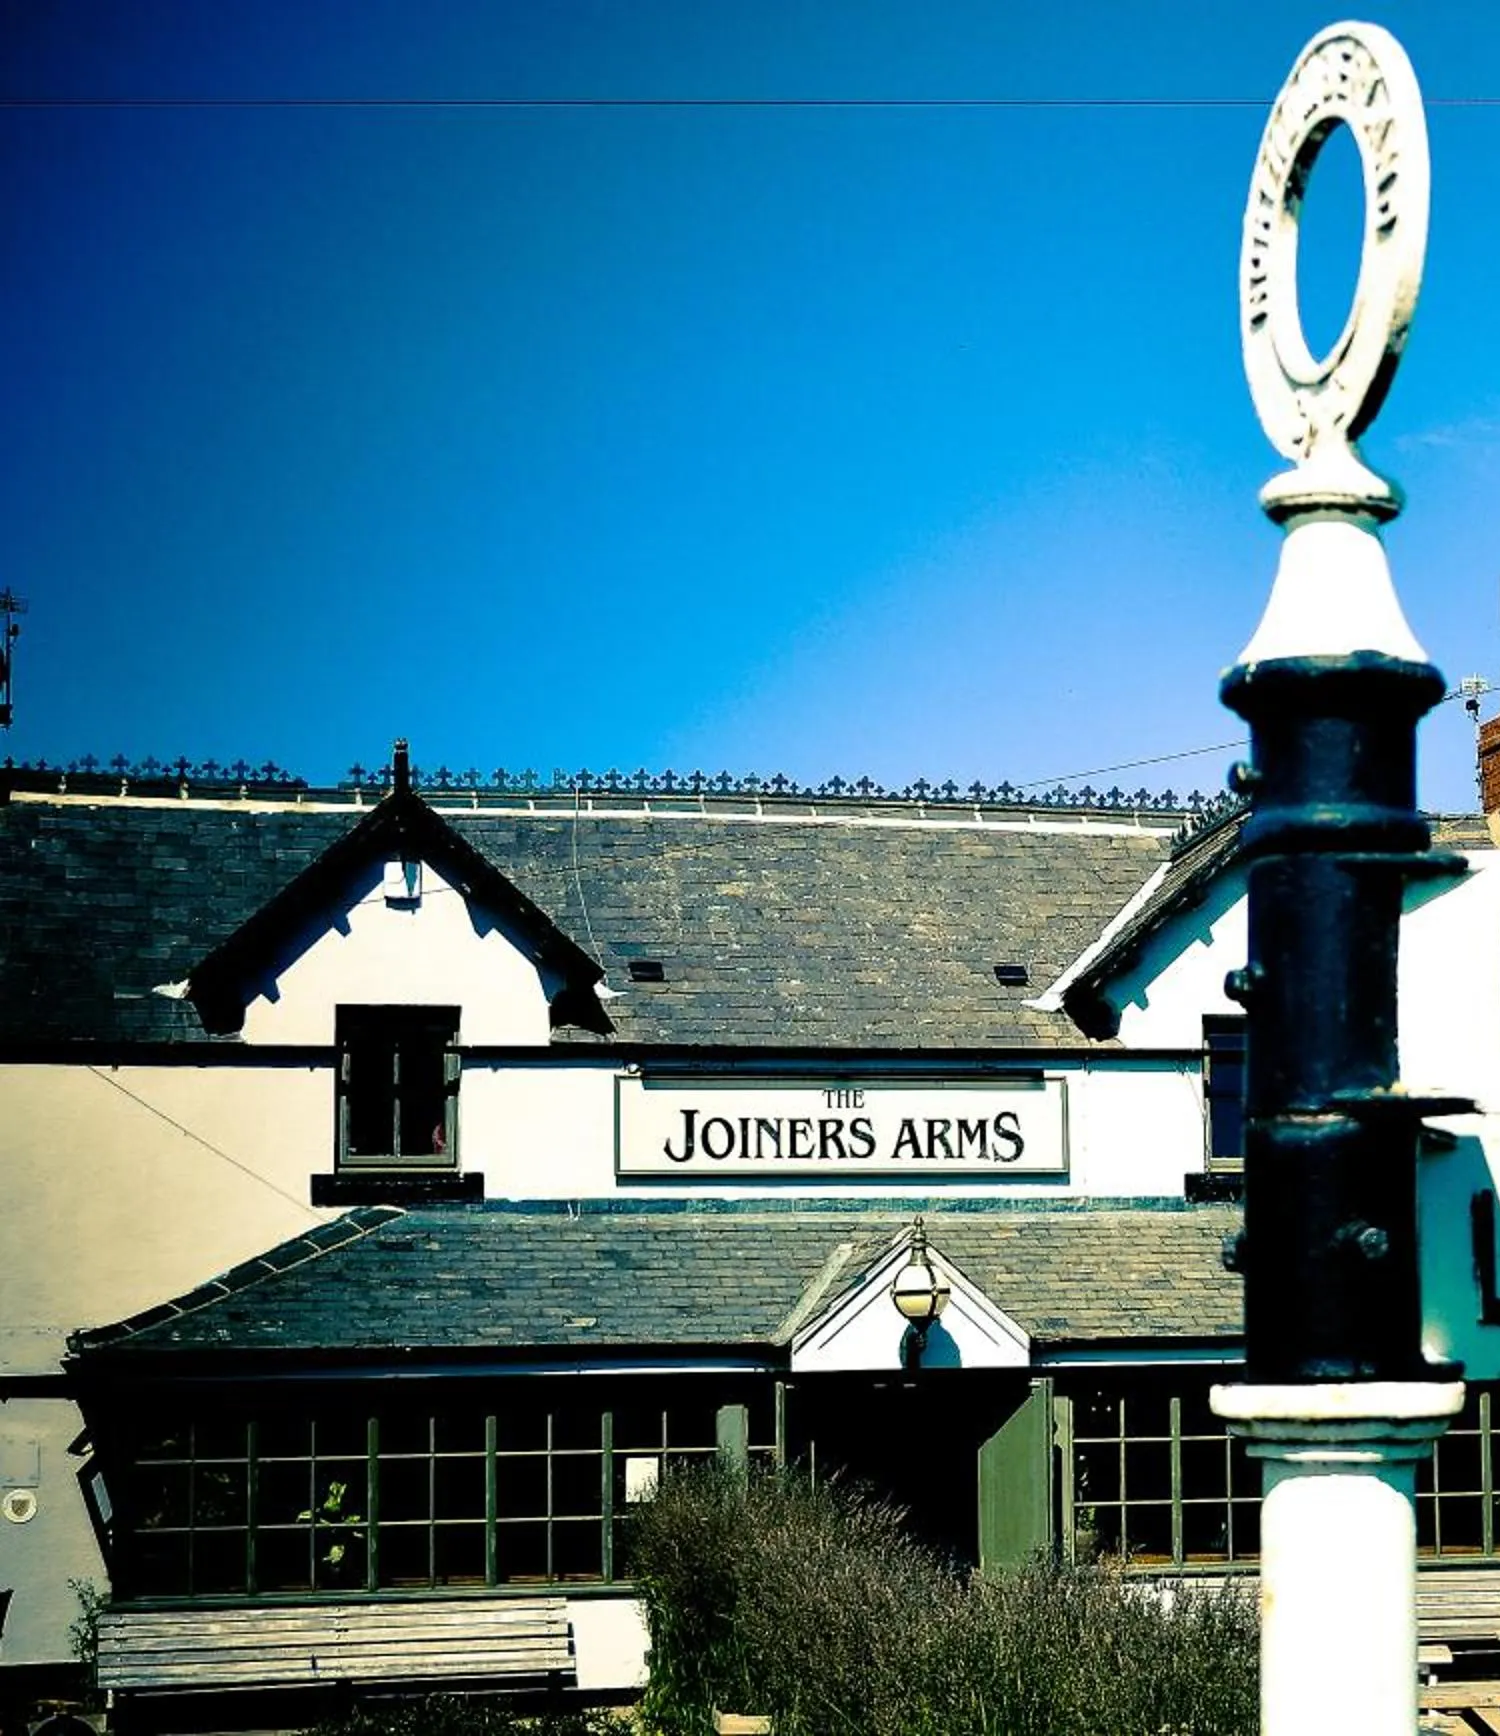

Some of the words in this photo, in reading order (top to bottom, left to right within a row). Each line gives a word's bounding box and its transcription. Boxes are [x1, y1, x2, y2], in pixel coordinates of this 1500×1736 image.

[822, 1089, 866, 1109] THE
[664, 1109, 877, 1163] JOINERS
[891, 1111, 1025, 1163] ARMS
